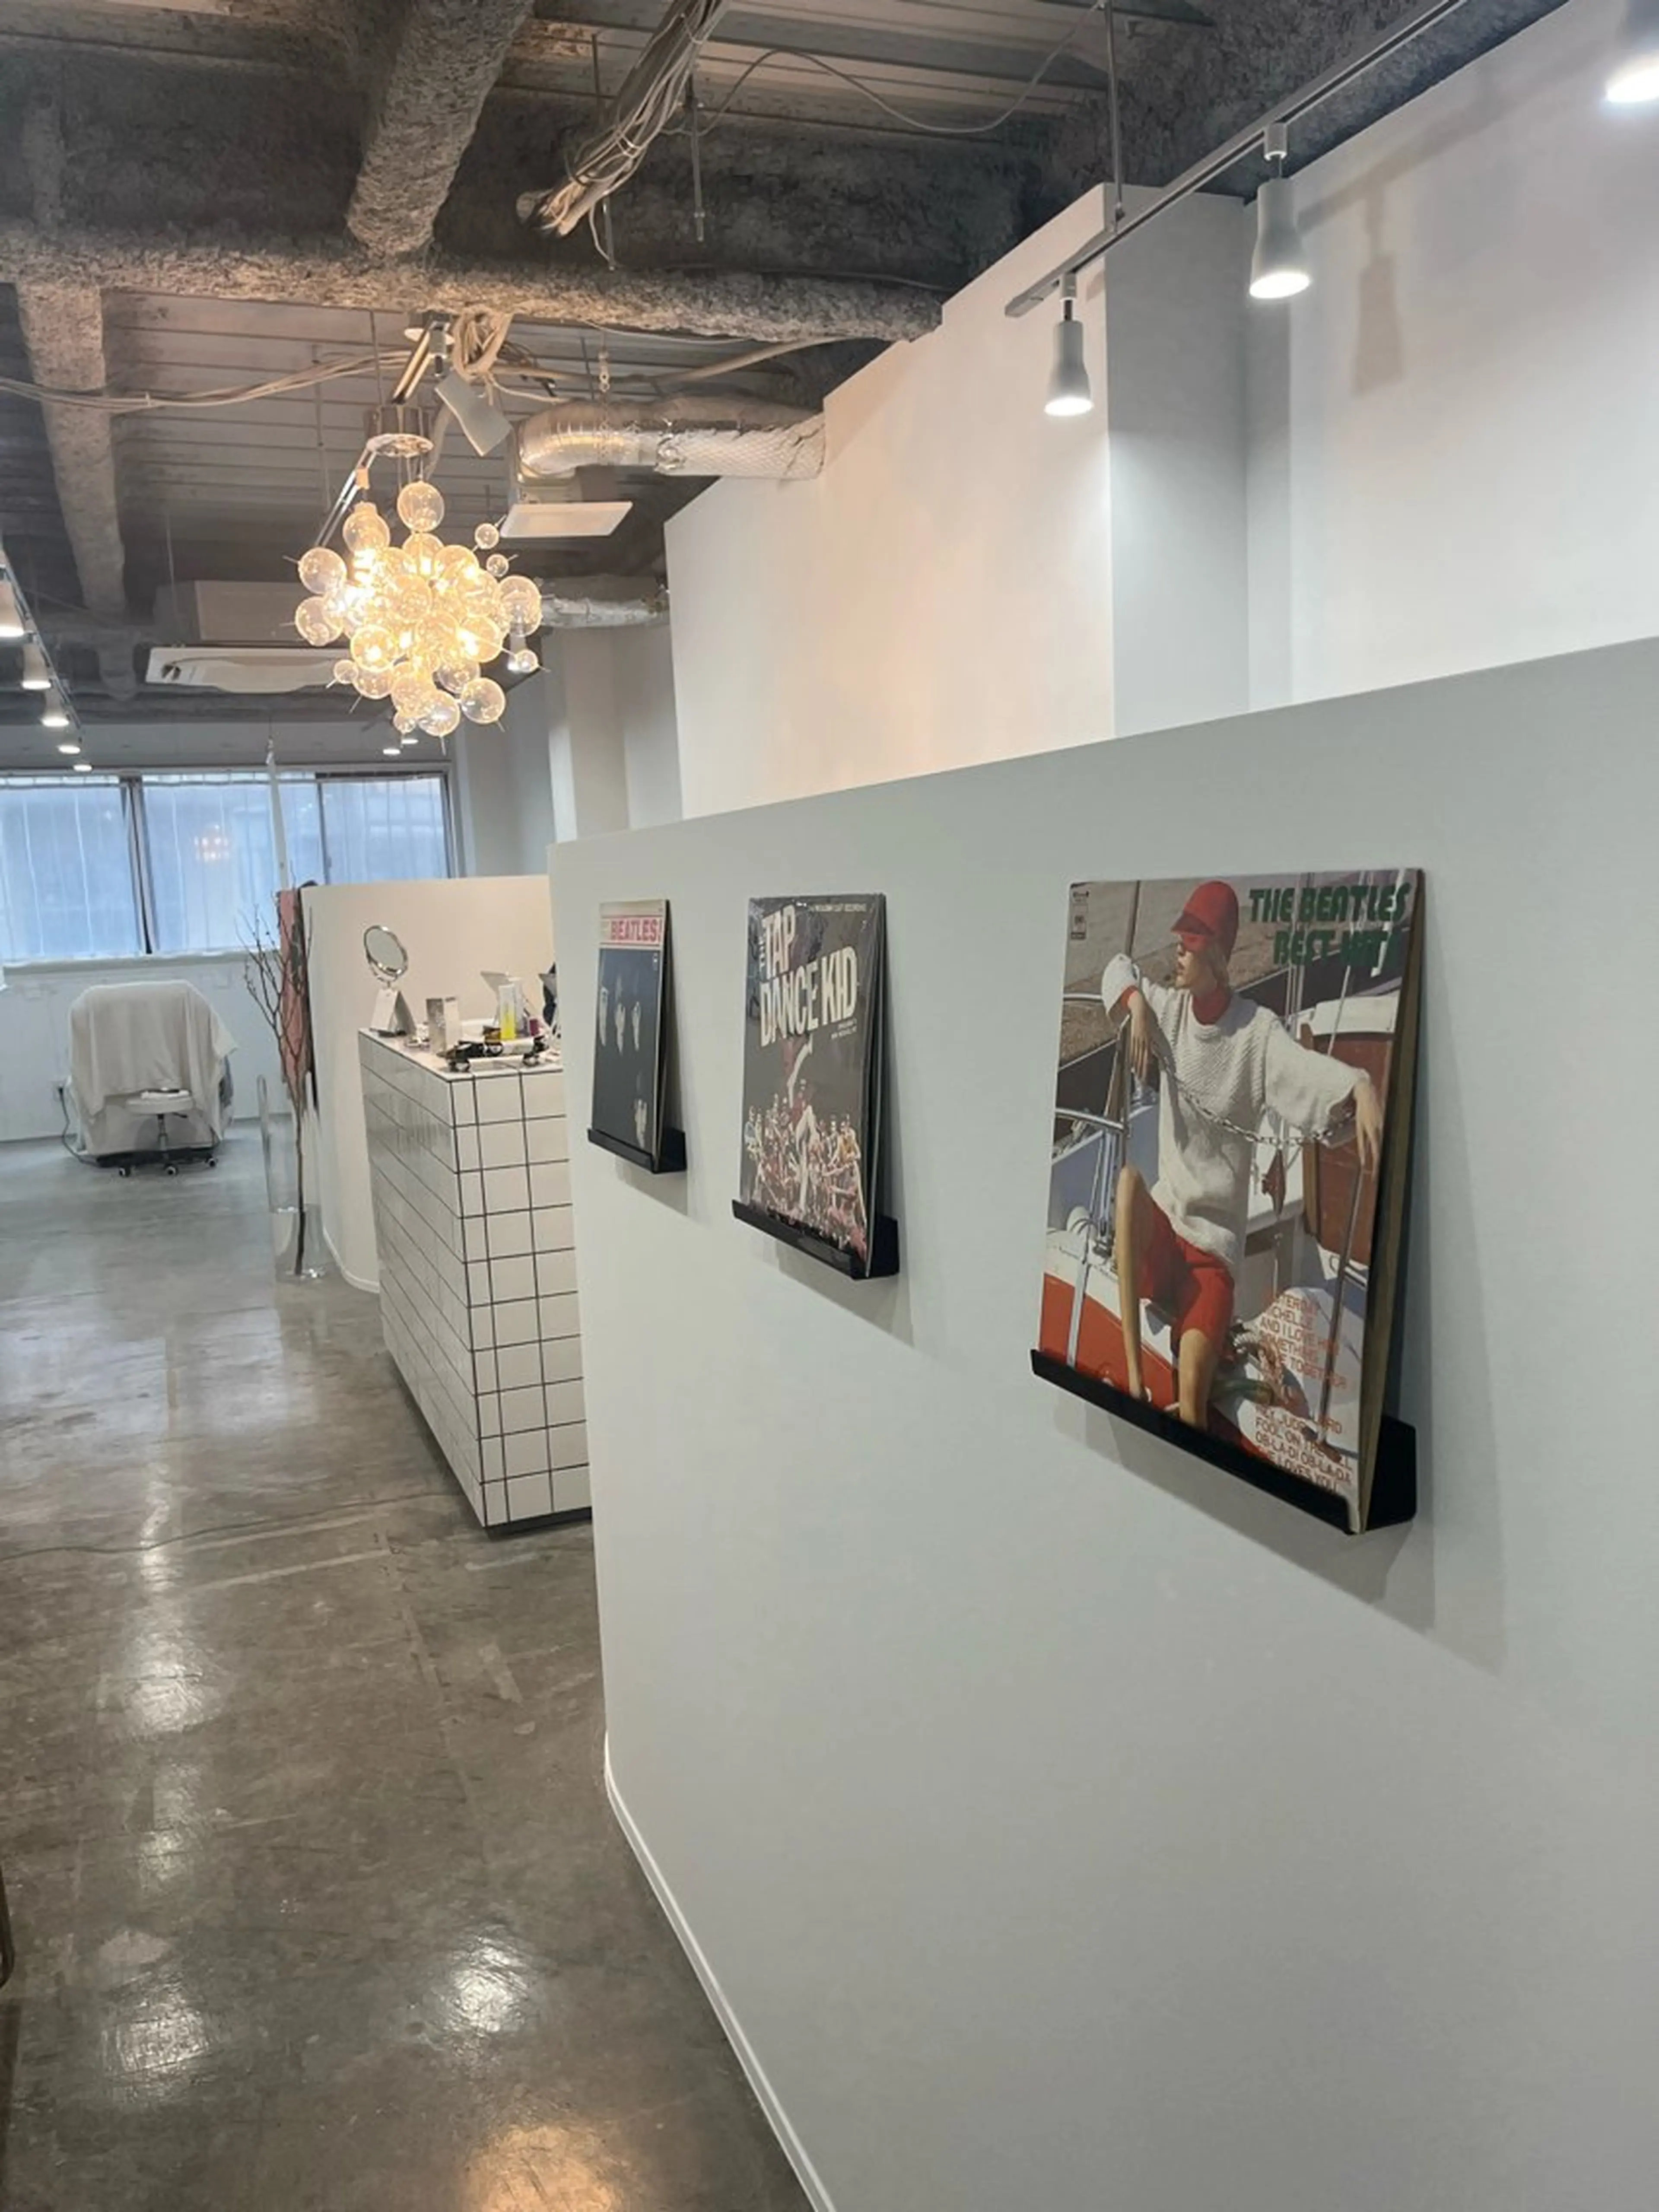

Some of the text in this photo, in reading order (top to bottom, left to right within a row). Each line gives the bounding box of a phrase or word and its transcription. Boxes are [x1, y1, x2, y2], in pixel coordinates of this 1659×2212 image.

[1249, 882, 1412, 922] THE BEATLES
[761, 904, 796, 980] TAP
[760, 960, 818, 1047] DANCE
[822, 946, 858, 1026] KID
